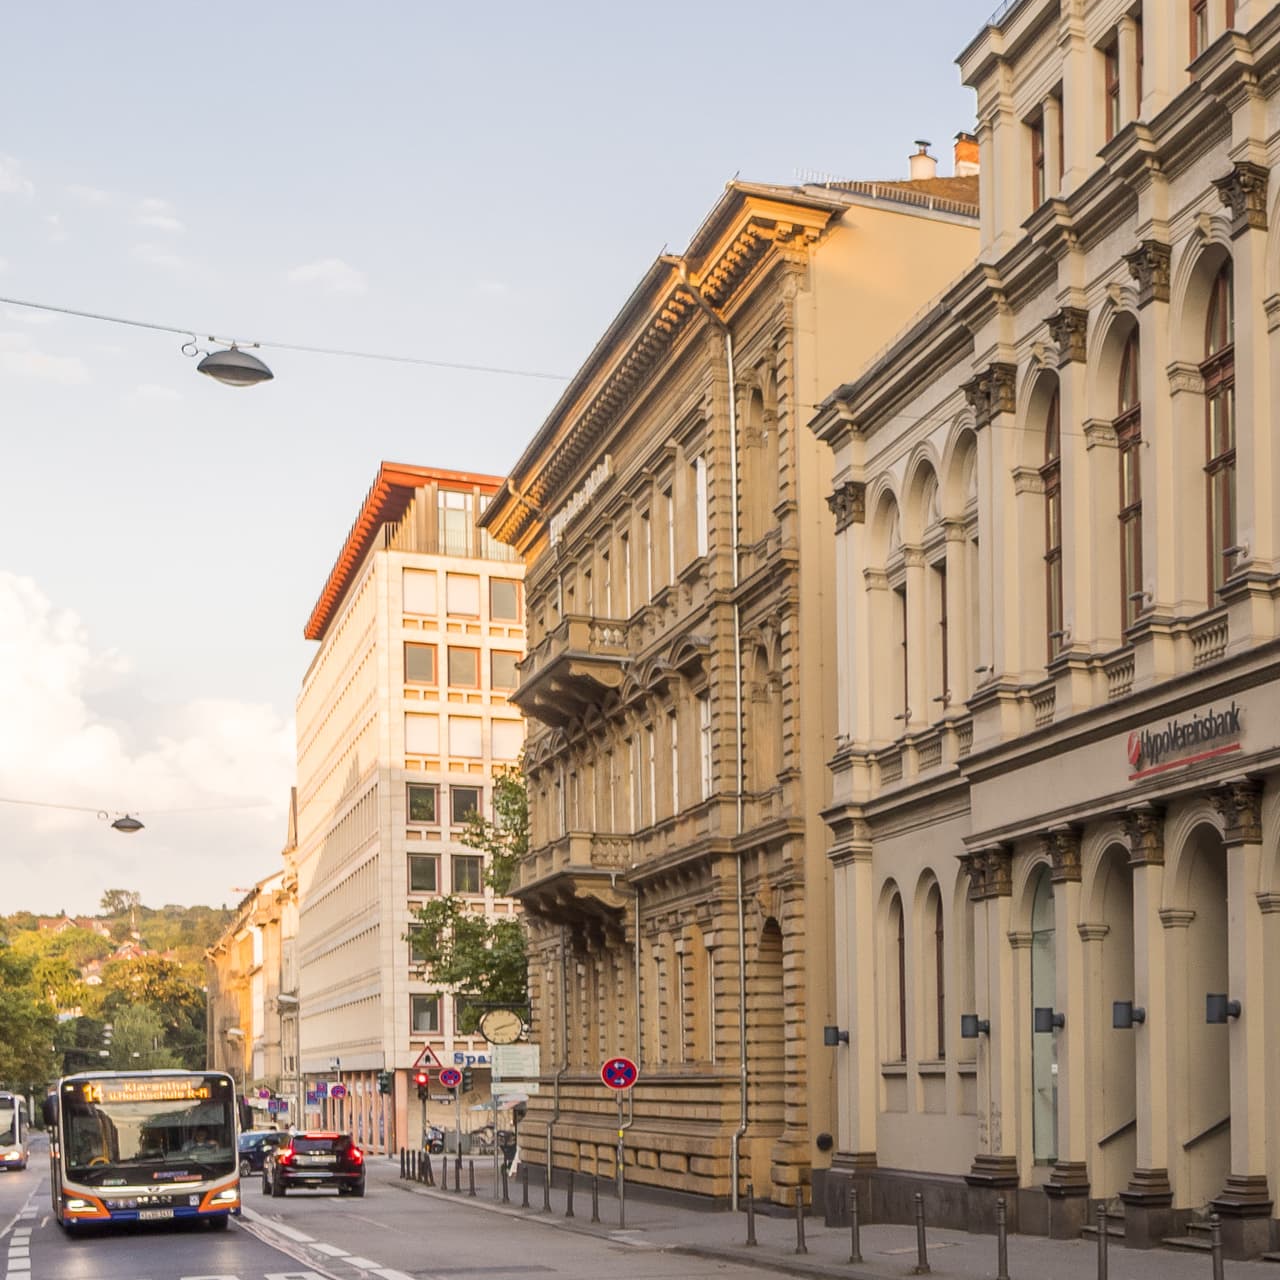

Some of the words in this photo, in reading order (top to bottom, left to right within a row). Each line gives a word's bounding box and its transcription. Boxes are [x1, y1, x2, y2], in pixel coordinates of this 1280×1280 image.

[1140, 700, 1241, 766] HypoVereinsbank
[82, 1083, 104, 1104] 14
[124, 1080, 192, 1092] Klarenthal
